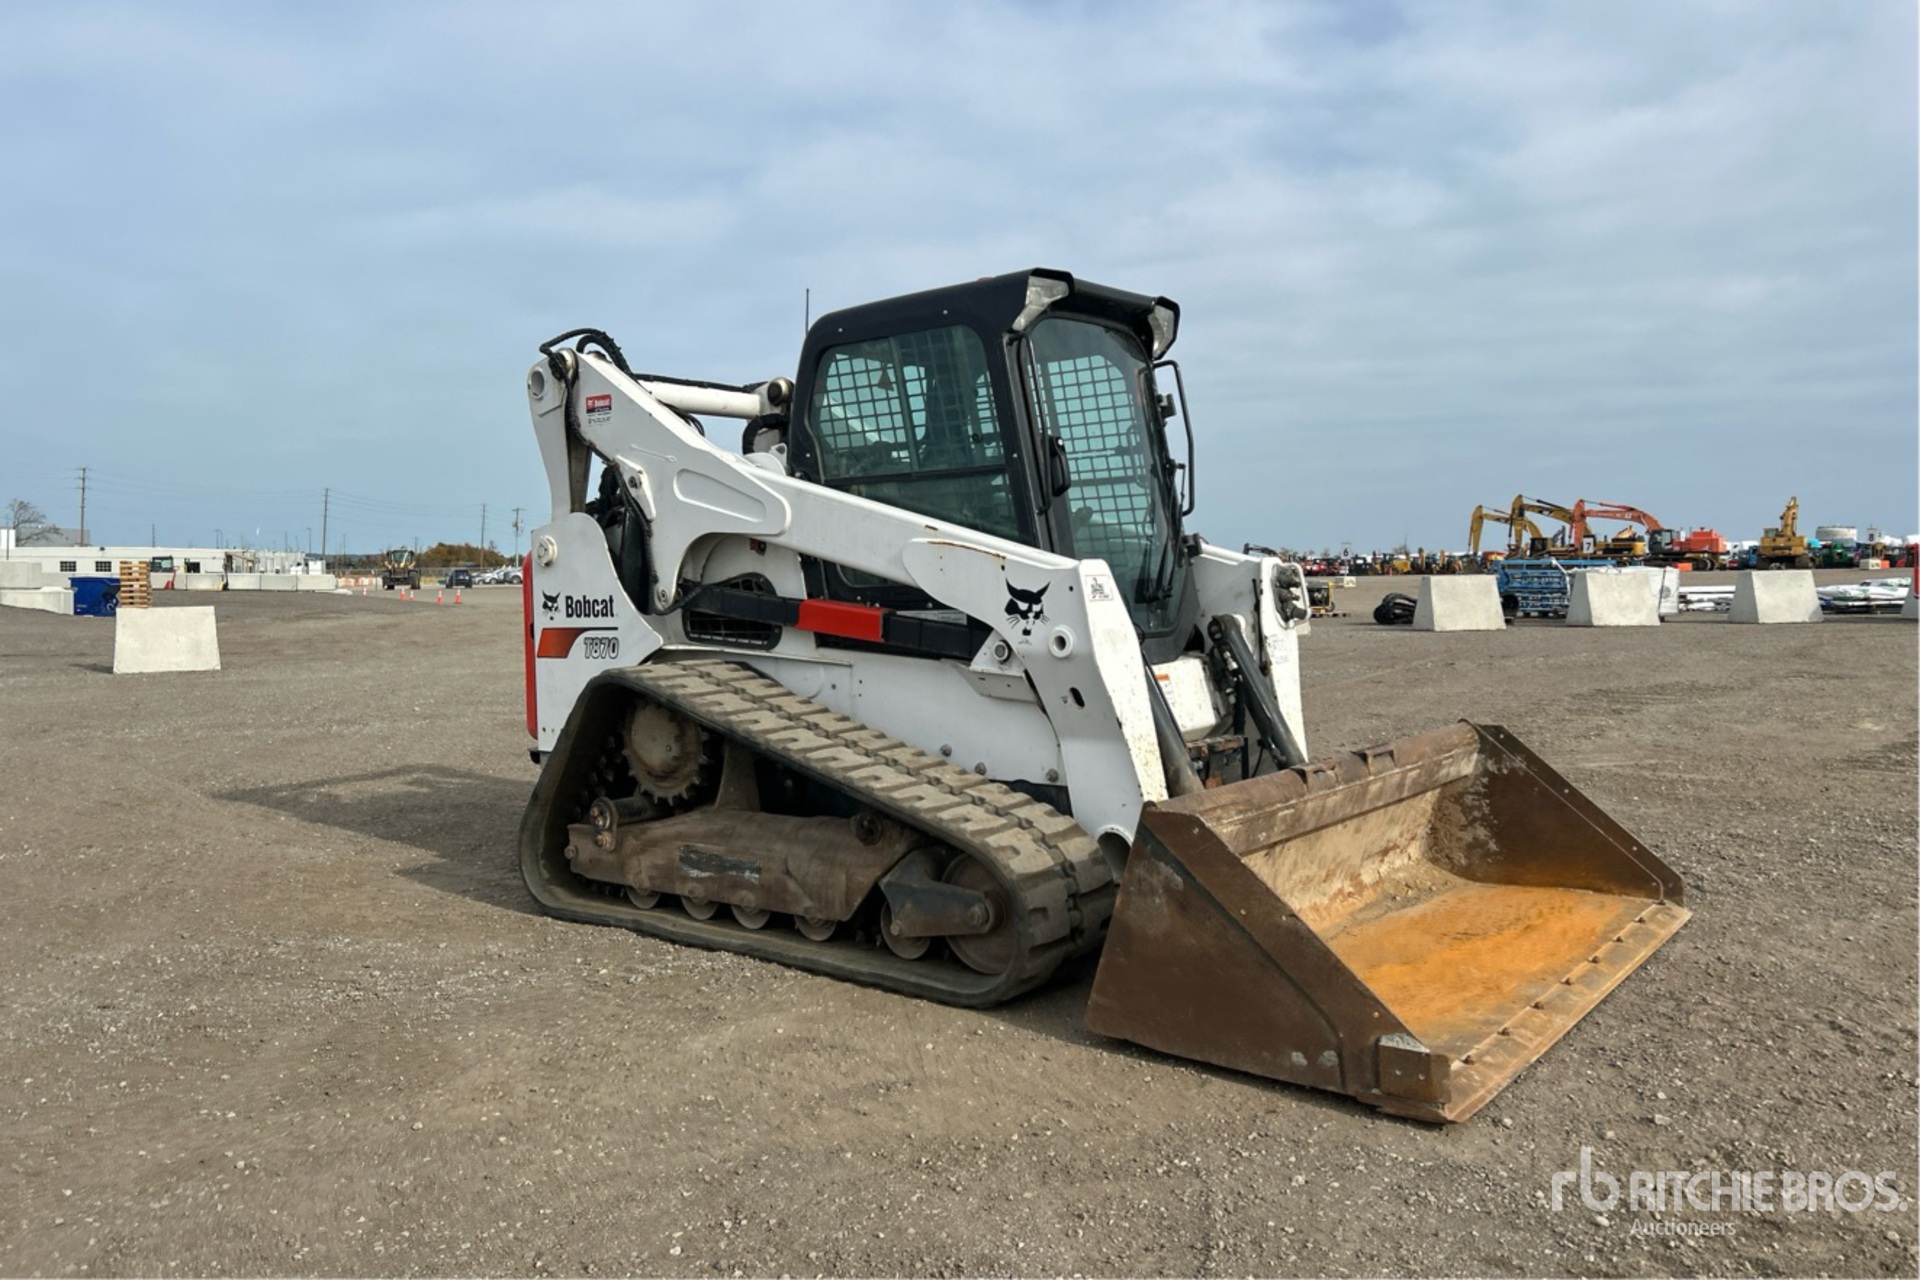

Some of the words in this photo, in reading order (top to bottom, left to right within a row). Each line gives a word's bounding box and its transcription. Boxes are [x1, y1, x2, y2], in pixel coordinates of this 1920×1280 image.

[1343, 548, 1349, 557] 6
[1585, 542, 1592, 551] 7
[565, 595, 615, 619] Bobcat
[583, 637, 620, 660] T870
